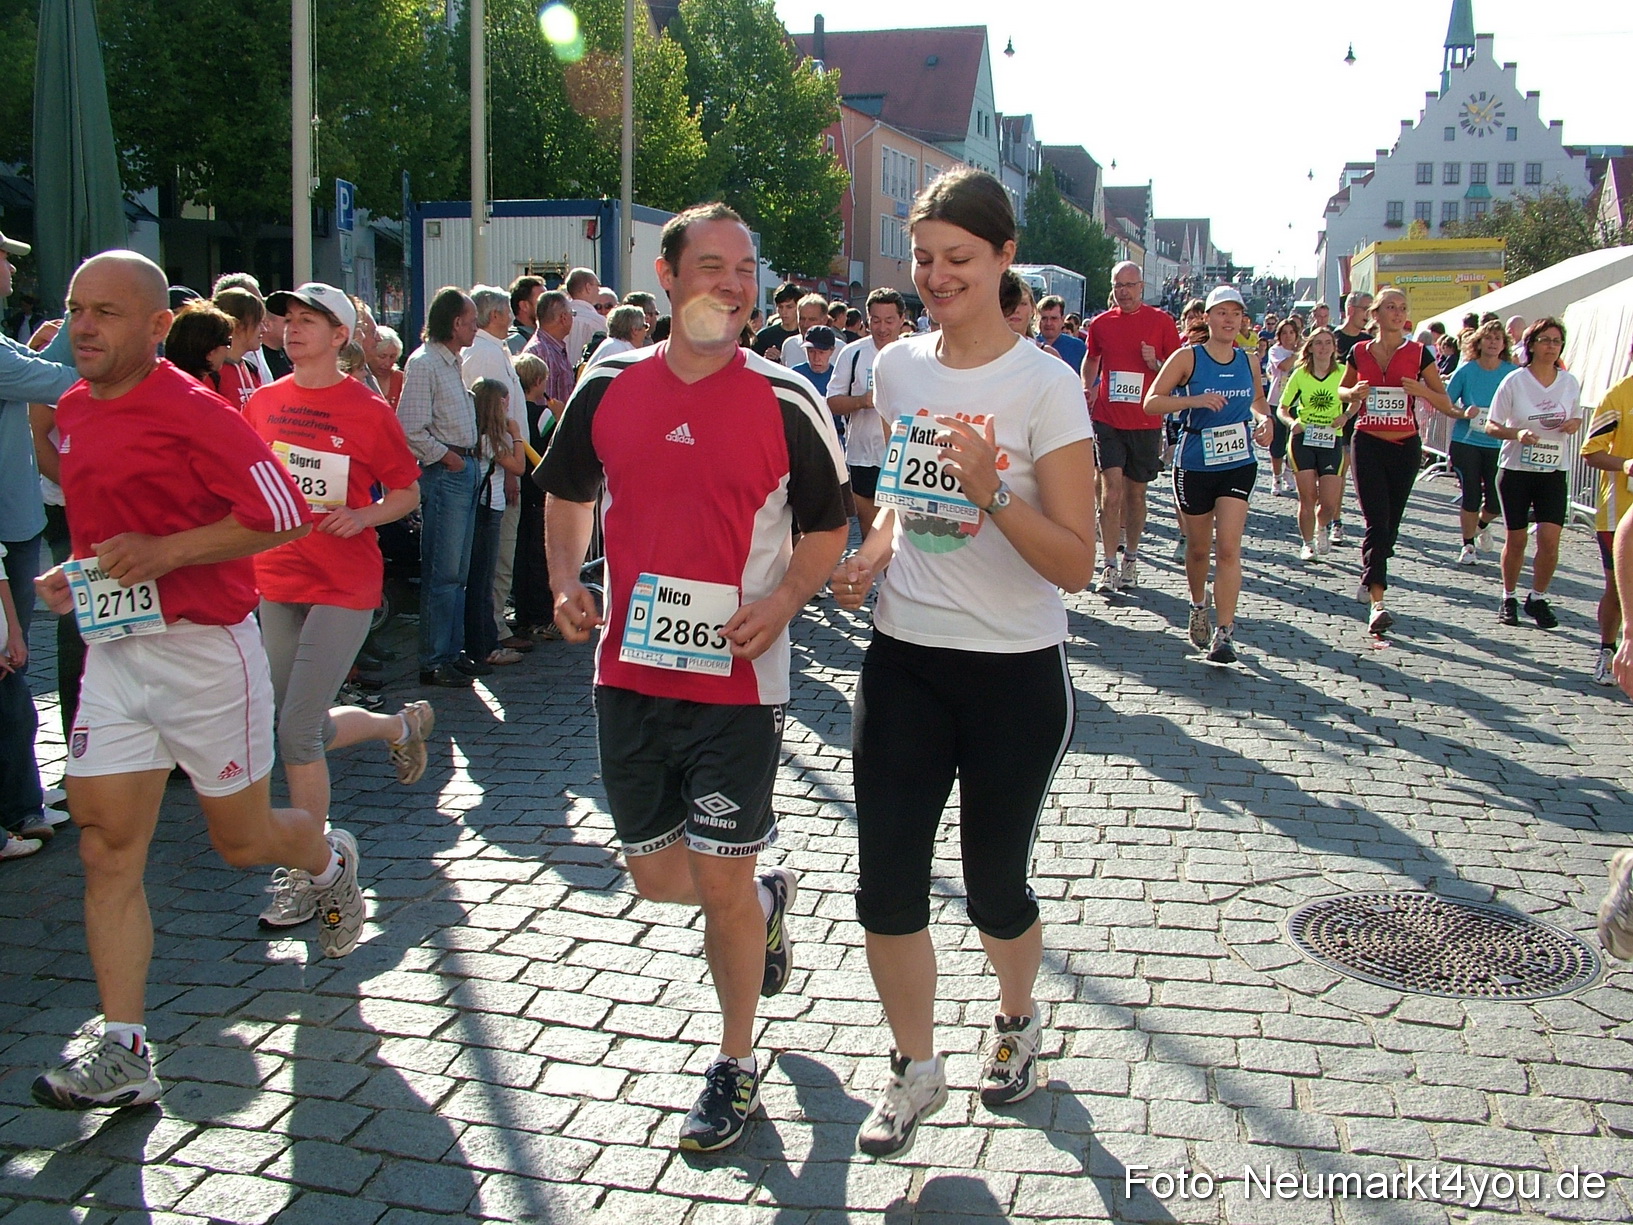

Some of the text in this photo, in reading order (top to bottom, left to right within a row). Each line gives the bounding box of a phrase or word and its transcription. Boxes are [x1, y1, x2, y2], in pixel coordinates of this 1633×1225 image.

[340, 186, 350, 223] P
[1116, 384, 1141, 395] 2866
[1377, 399, 1405, 409] 3359
[280, 404, 331, 419] Laufteam
[665, 434, 695, 446] adidas
[1312, 432, 1333, 441] 2854
[1215, 438, 1245, 454] 2148
[289, 452, 321, 470] Sigrid
[888, 449, 899, 463] D
[1531, 452, 1559, 464] 2337
[939, 503, 978, 517] PFLEIDERER
[77, 592, 88, 606] D
[97, 585, 153, 619] 2713
[657, 586, 692, 607] Nico
[633, 607, 646, 621] D
[653, 616, 727, 650] 2863
[688, 658, 730, 670] PFLEIDERER
[694, 813, 737, 830] UMBRO
